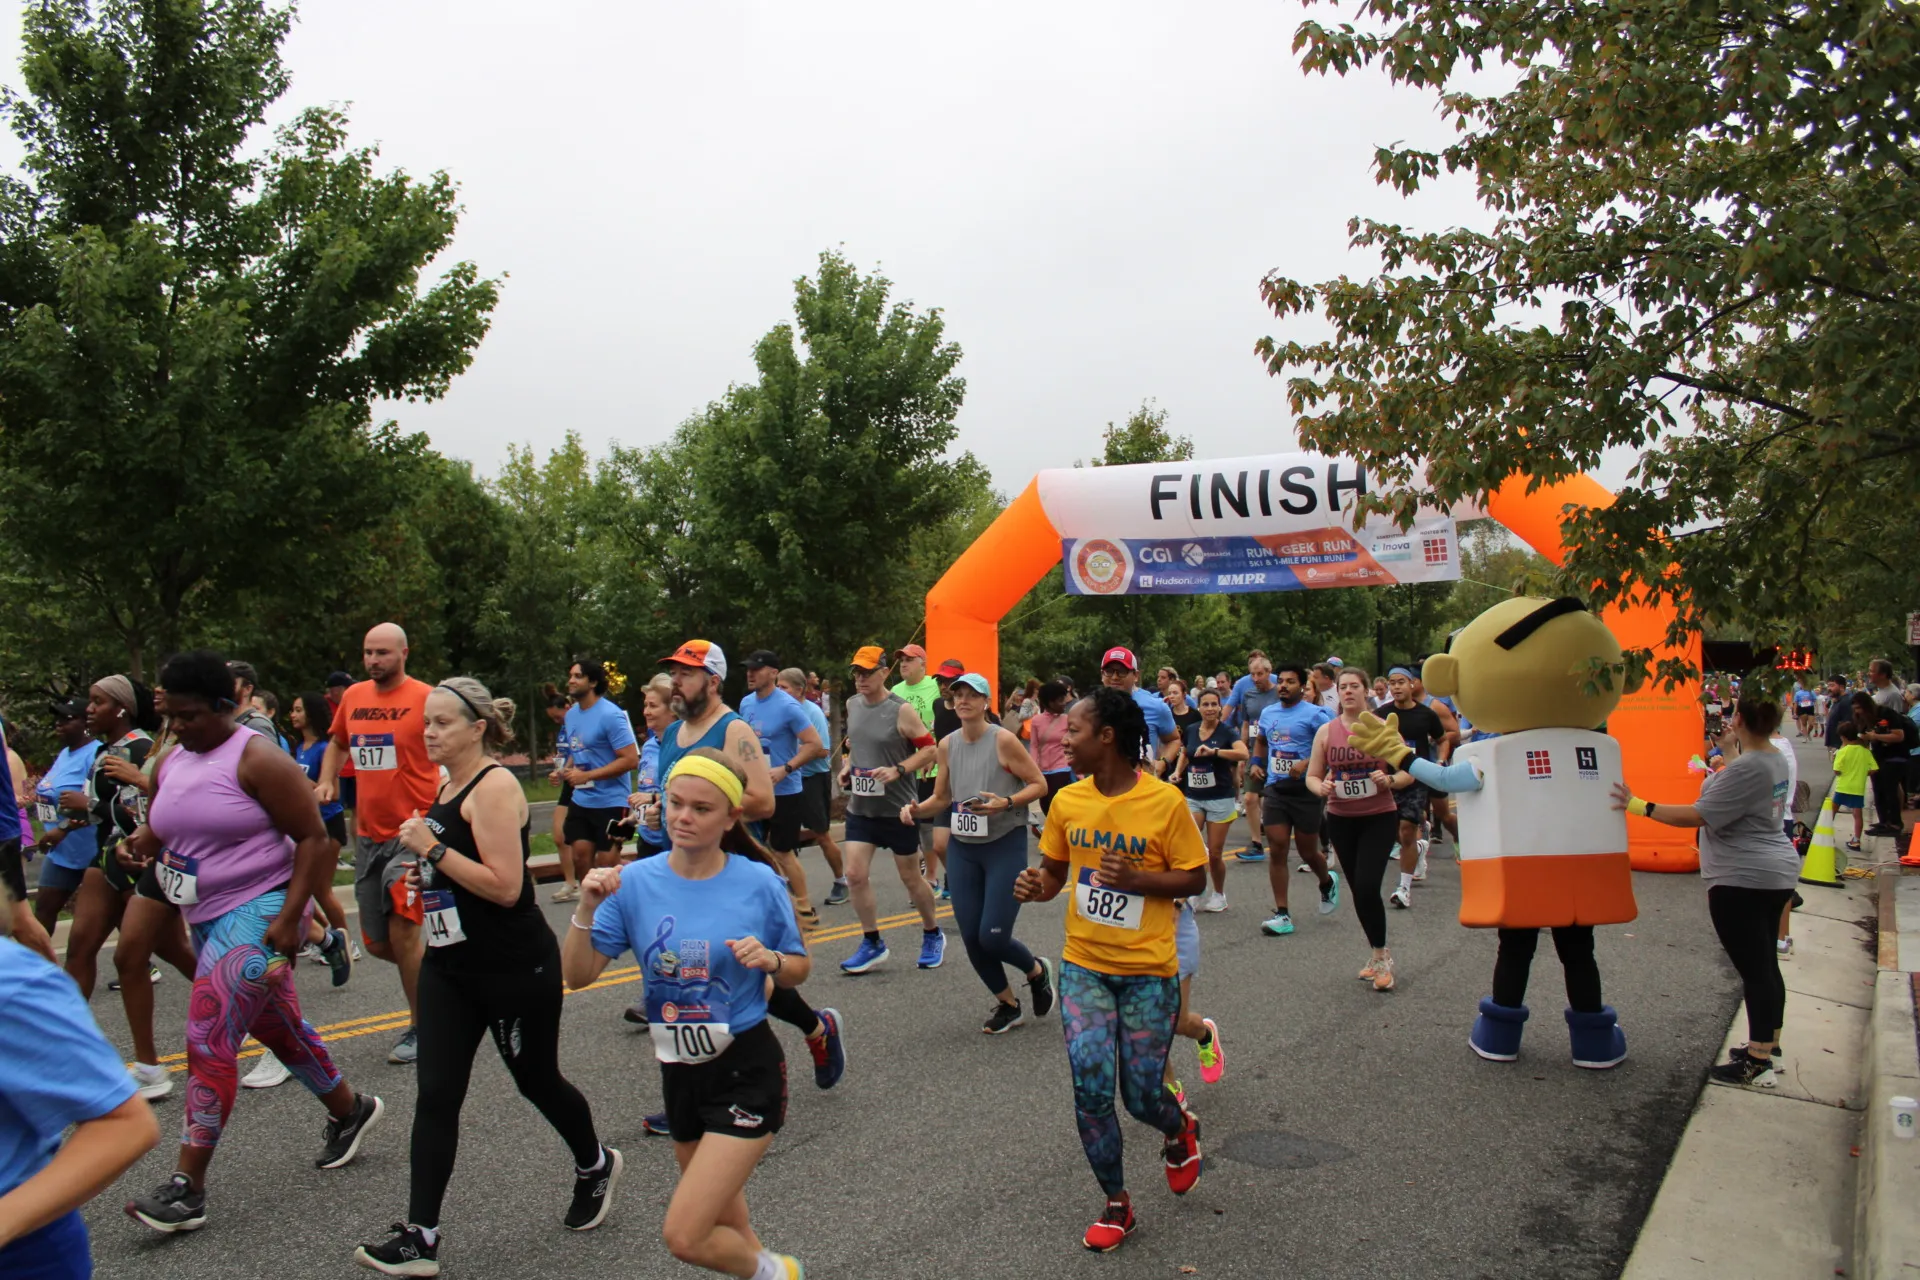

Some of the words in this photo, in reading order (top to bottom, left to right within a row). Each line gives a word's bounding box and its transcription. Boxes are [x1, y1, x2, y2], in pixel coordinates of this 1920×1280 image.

[1150, 462, 1367, 520] FINISH
[1139, 547, 1174, 564] CGI
[1301, 556, 1322, 564] FUN!
[1323, 554, 1346, 562] RUN!
[1230, 573, 1267, 586] MPR
[359, 747, 384, 766] 617
[1275, 758, 1293, 771] 533
[855, 778, 876, 792] 802
[1192, 774, 1209, 785] 556
[1343, 780, 1367, 796] 661
[957, 815, 978, 832] 506
[1069, 828, 1147, 856] ULMAN
[163, 867, 183, 899] 372
[1087, 888, 1129, 922] 582
[683, 968, 708, 978] 2024
[665, 1024, 717, 1058] 700
